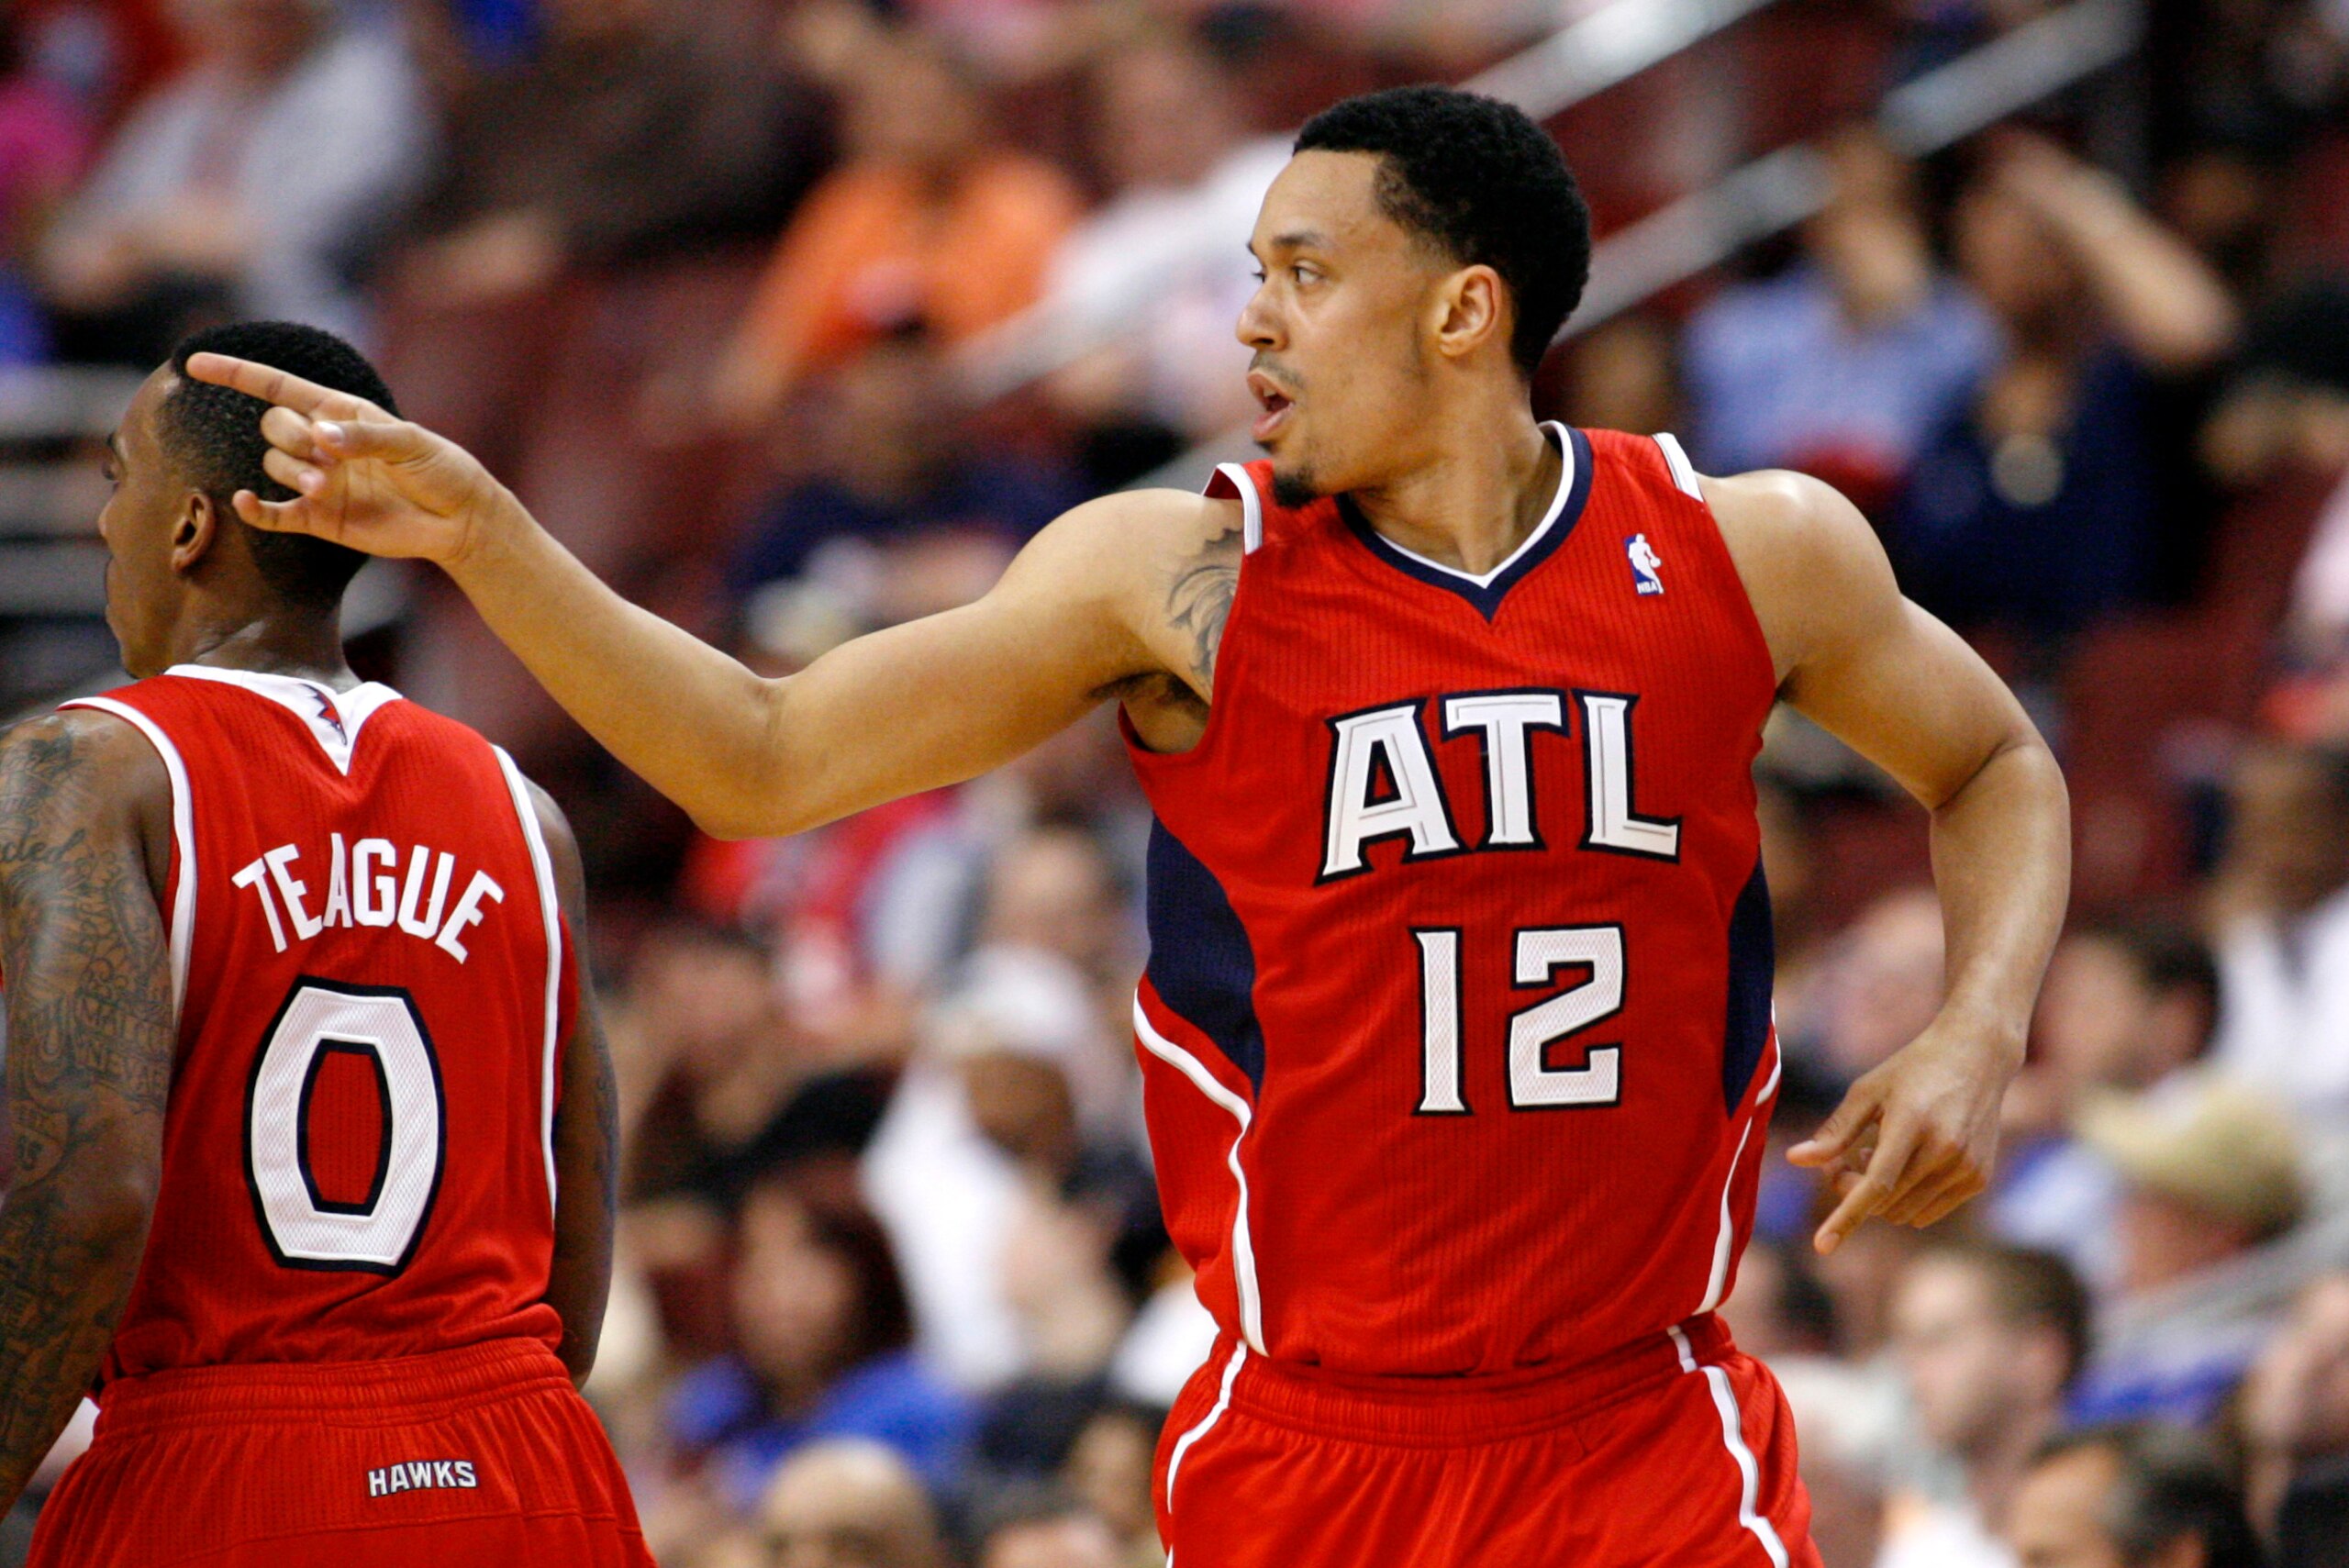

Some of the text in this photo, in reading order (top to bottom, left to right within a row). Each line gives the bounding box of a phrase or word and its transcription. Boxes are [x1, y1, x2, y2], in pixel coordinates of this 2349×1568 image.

[1315, 688, 1682, 885] ATL
[231, 832, 505, 964] TEAGUE
[1409, 923, 1627, 1115] 12
[244, 976, 444, 1273] 0
[368, 1460, 477, 1497] HAWKS
